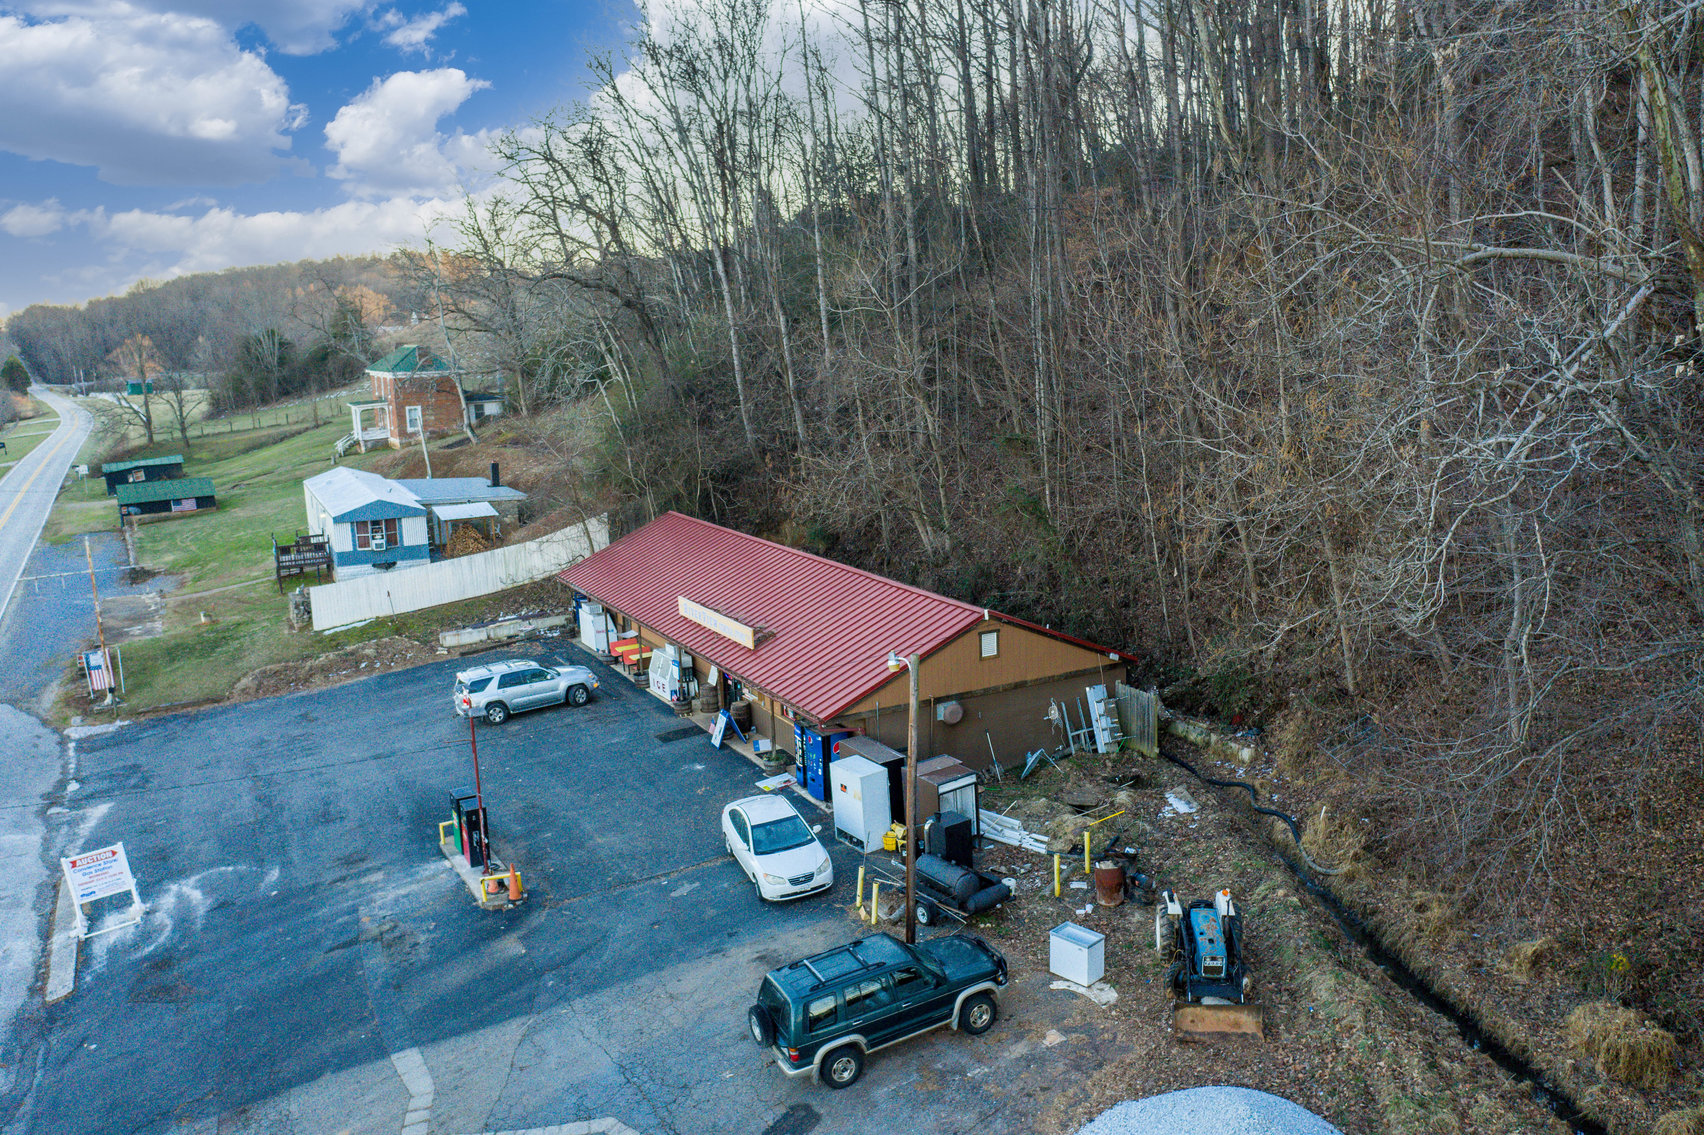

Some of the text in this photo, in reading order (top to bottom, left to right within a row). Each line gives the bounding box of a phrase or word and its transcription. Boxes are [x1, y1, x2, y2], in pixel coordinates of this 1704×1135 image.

[653, 678, 667, 693] ICE
[76, 851, 113, 866] AUCTION
[94, 865, 112, 874] Station
